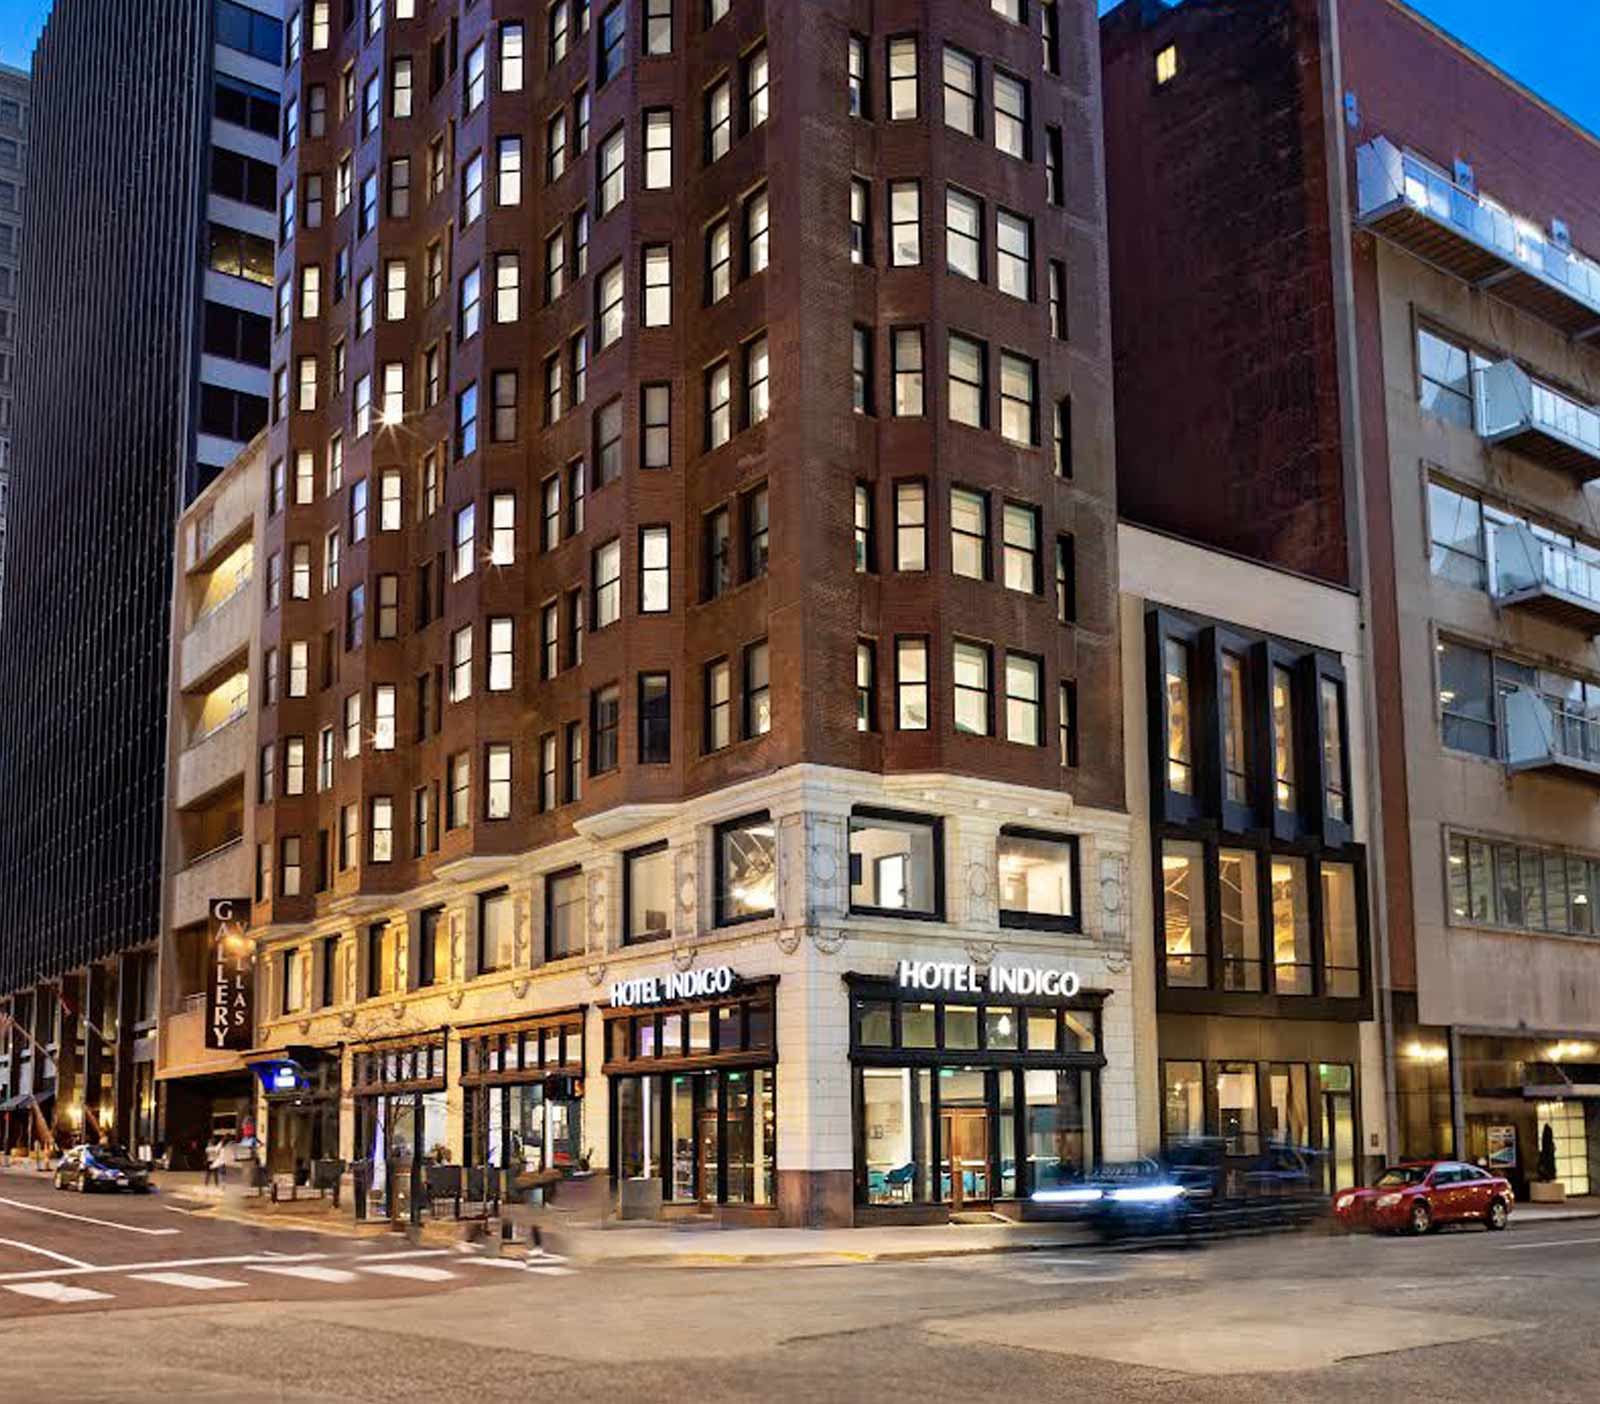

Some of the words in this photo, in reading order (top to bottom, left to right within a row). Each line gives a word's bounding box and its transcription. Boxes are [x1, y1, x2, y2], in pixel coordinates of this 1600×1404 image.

[213, 901, 233, 1047] GALLERY
[234, 921, 248, 1025] VLLAS
[611, 977, 661, 1007] HOTEL
[665, 966, 731, 999] INDIGO
[900, 959, 982, 992] HOTEL
[989, 966, 1080, 997] INDIGO
